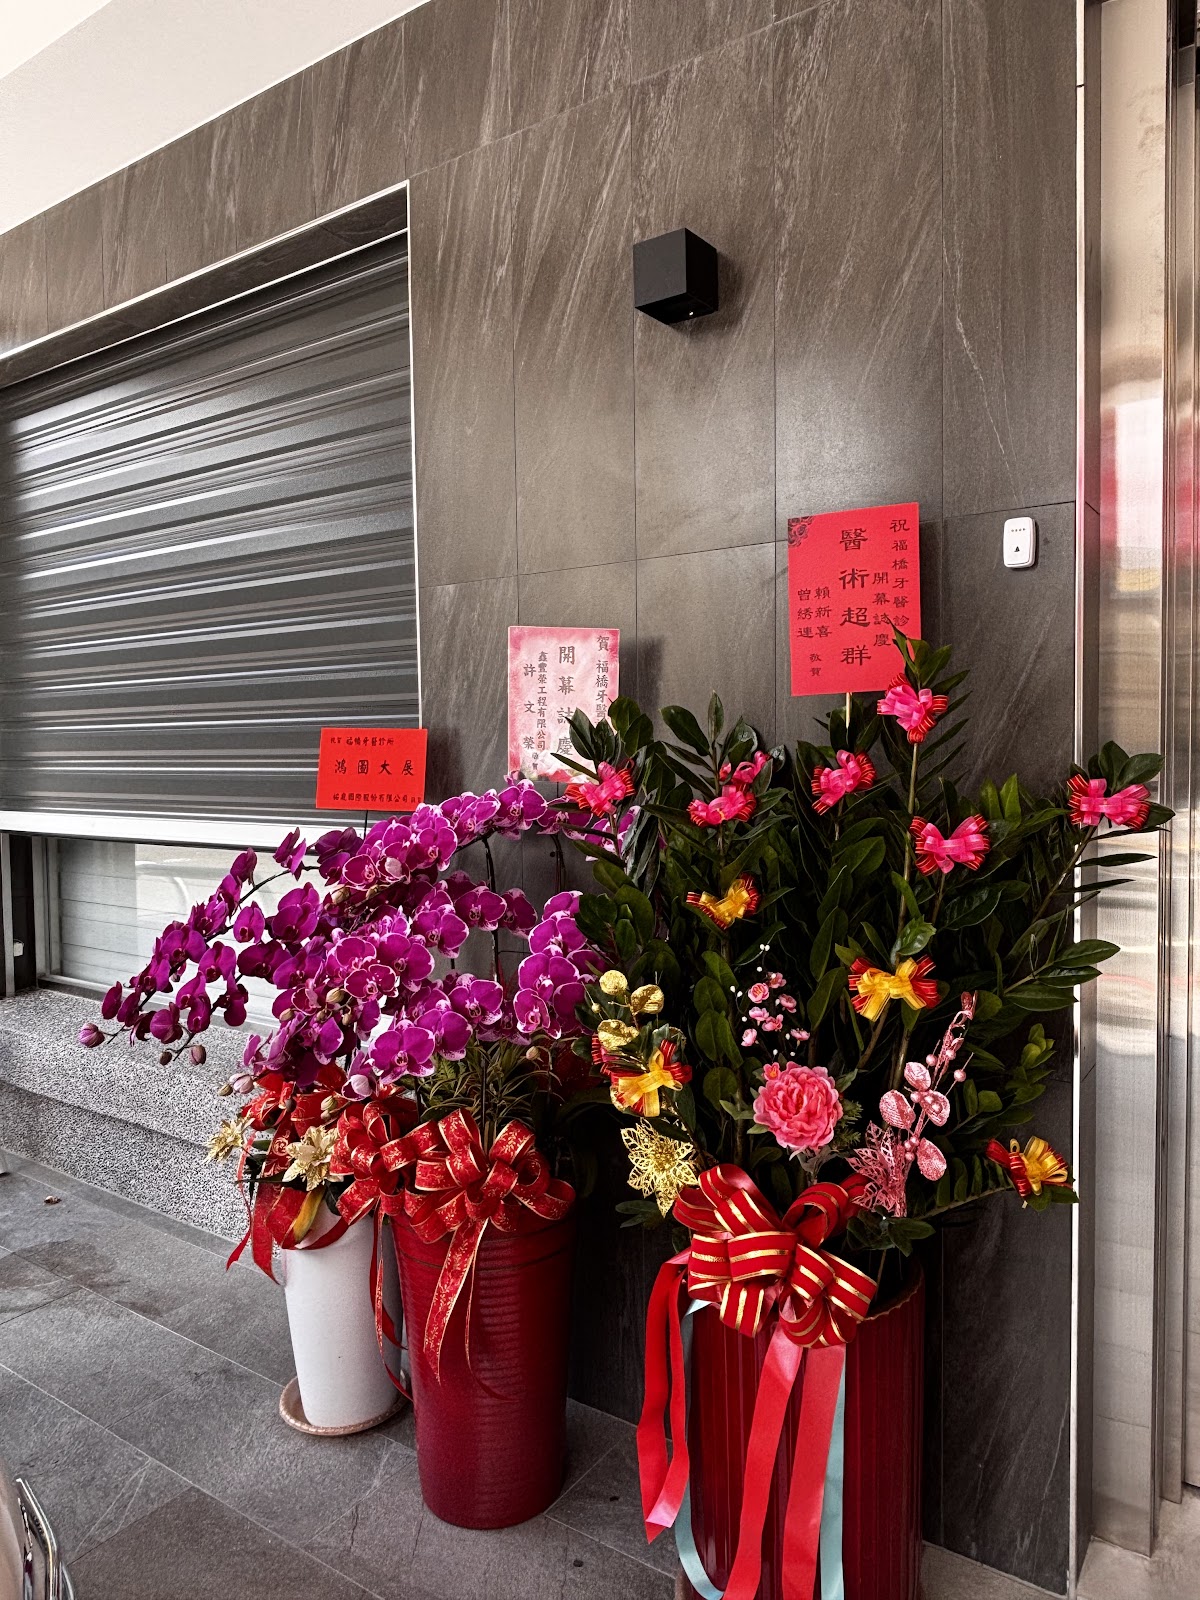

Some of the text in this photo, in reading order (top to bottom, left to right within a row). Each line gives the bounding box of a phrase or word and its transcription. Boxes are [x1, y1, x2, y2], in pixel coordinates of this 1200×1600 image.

[814, 586, 832, 638] 賴新喜
[839, 528, 871, 666] 醫術超群
[872, 572, 892, 648] 開幕誌慶
[890, 519, 910, 638] 祝福橋牙醫診
[523, 663, 536, 750] 許文榮
[595, 660, 609, 723] 福橋牙醫
[334, 759, 414, 776] 鴻圖大展
